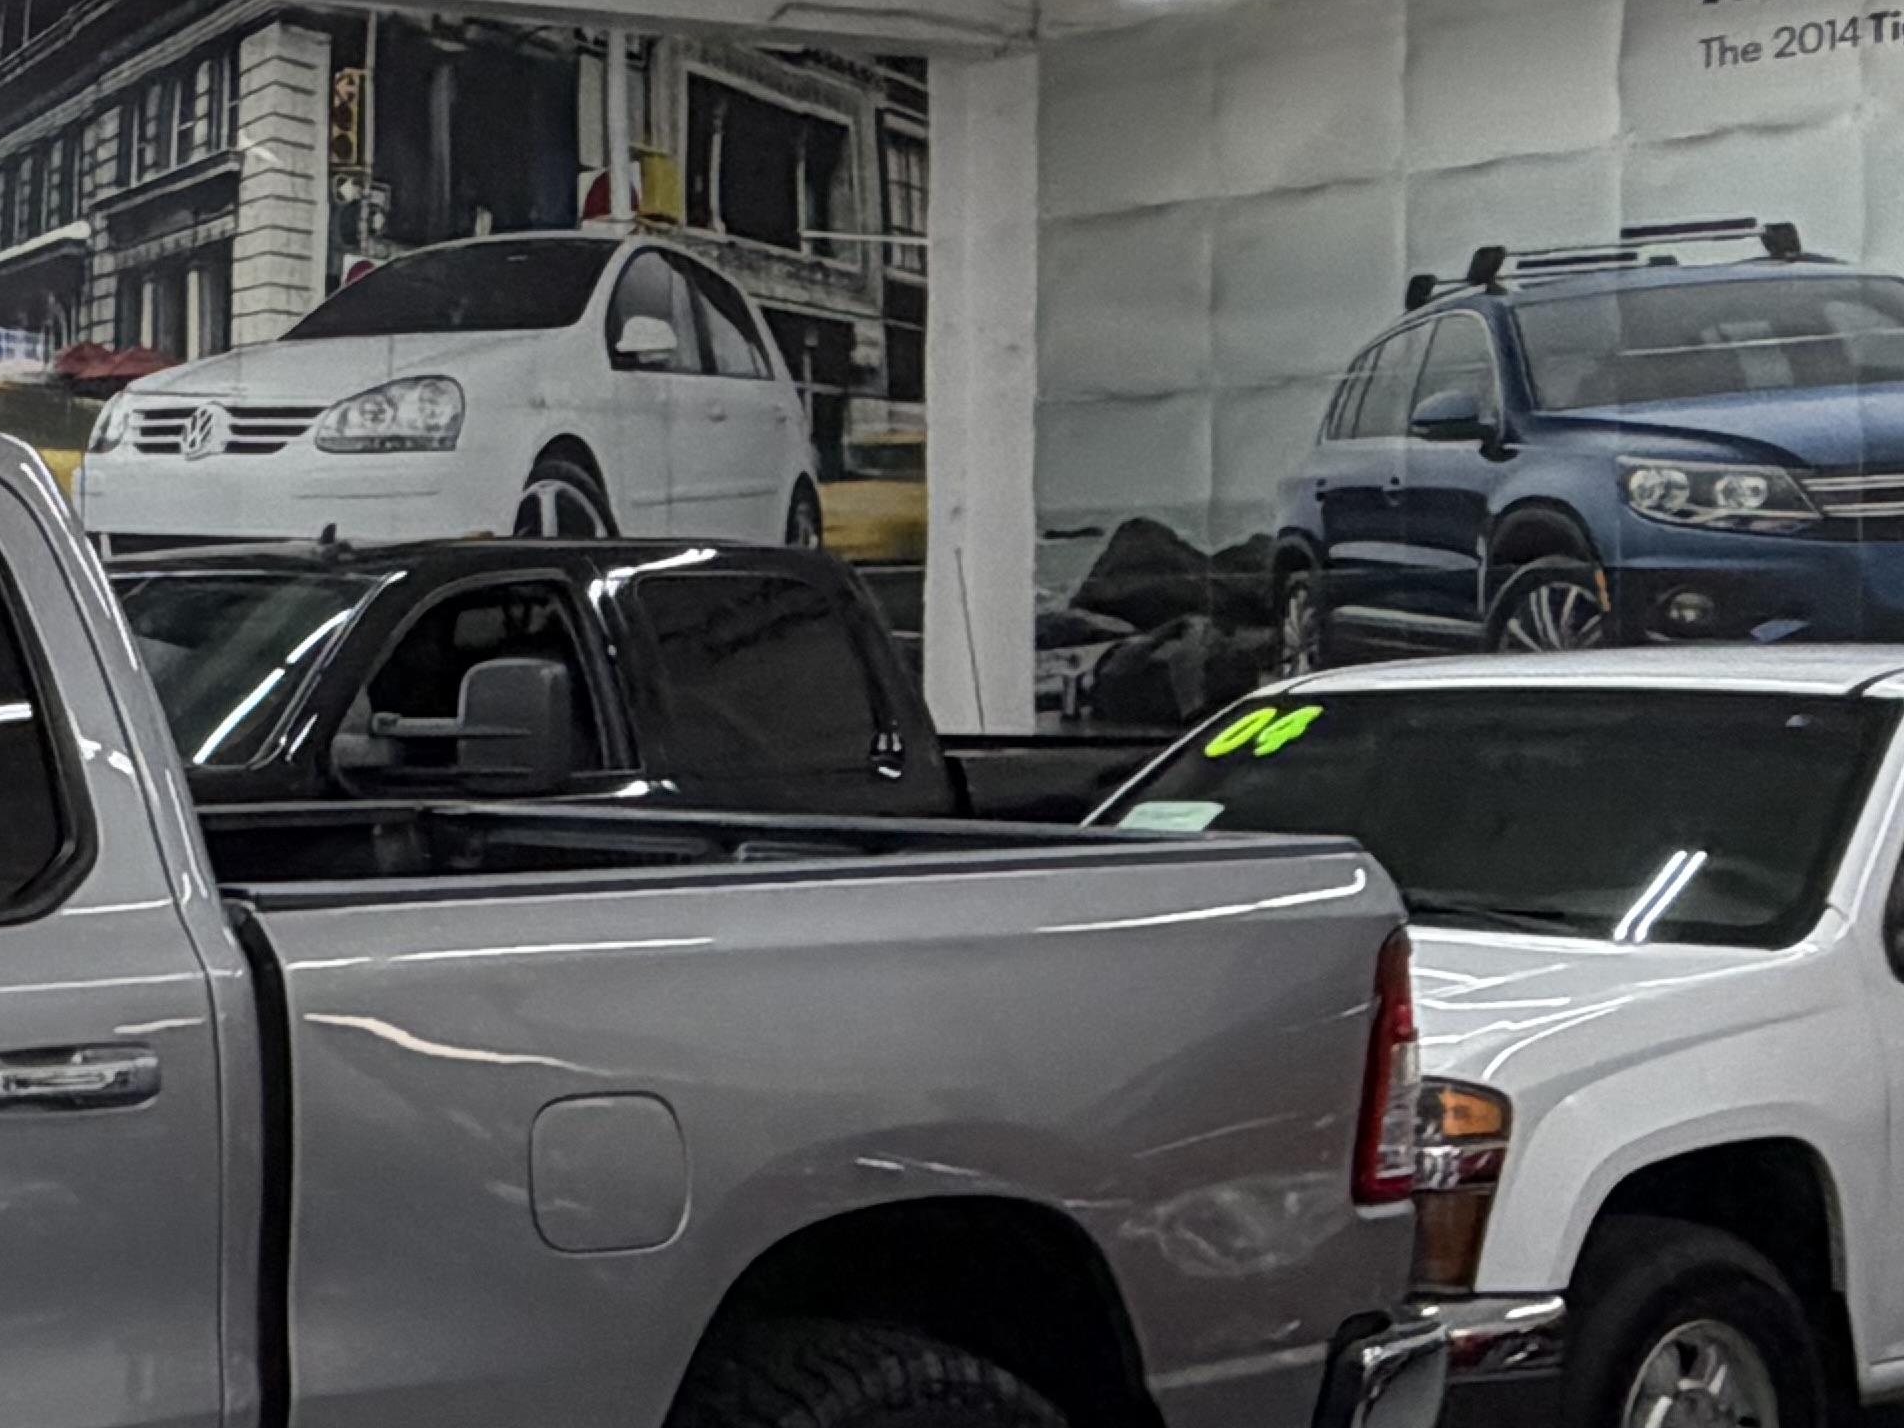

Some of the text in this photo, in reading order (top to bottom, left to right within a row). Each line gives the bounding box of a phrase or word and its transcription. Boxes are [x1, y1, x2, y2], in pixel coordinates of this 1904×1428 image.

[1699, 10, 1904, 69] The 2014 Ti
